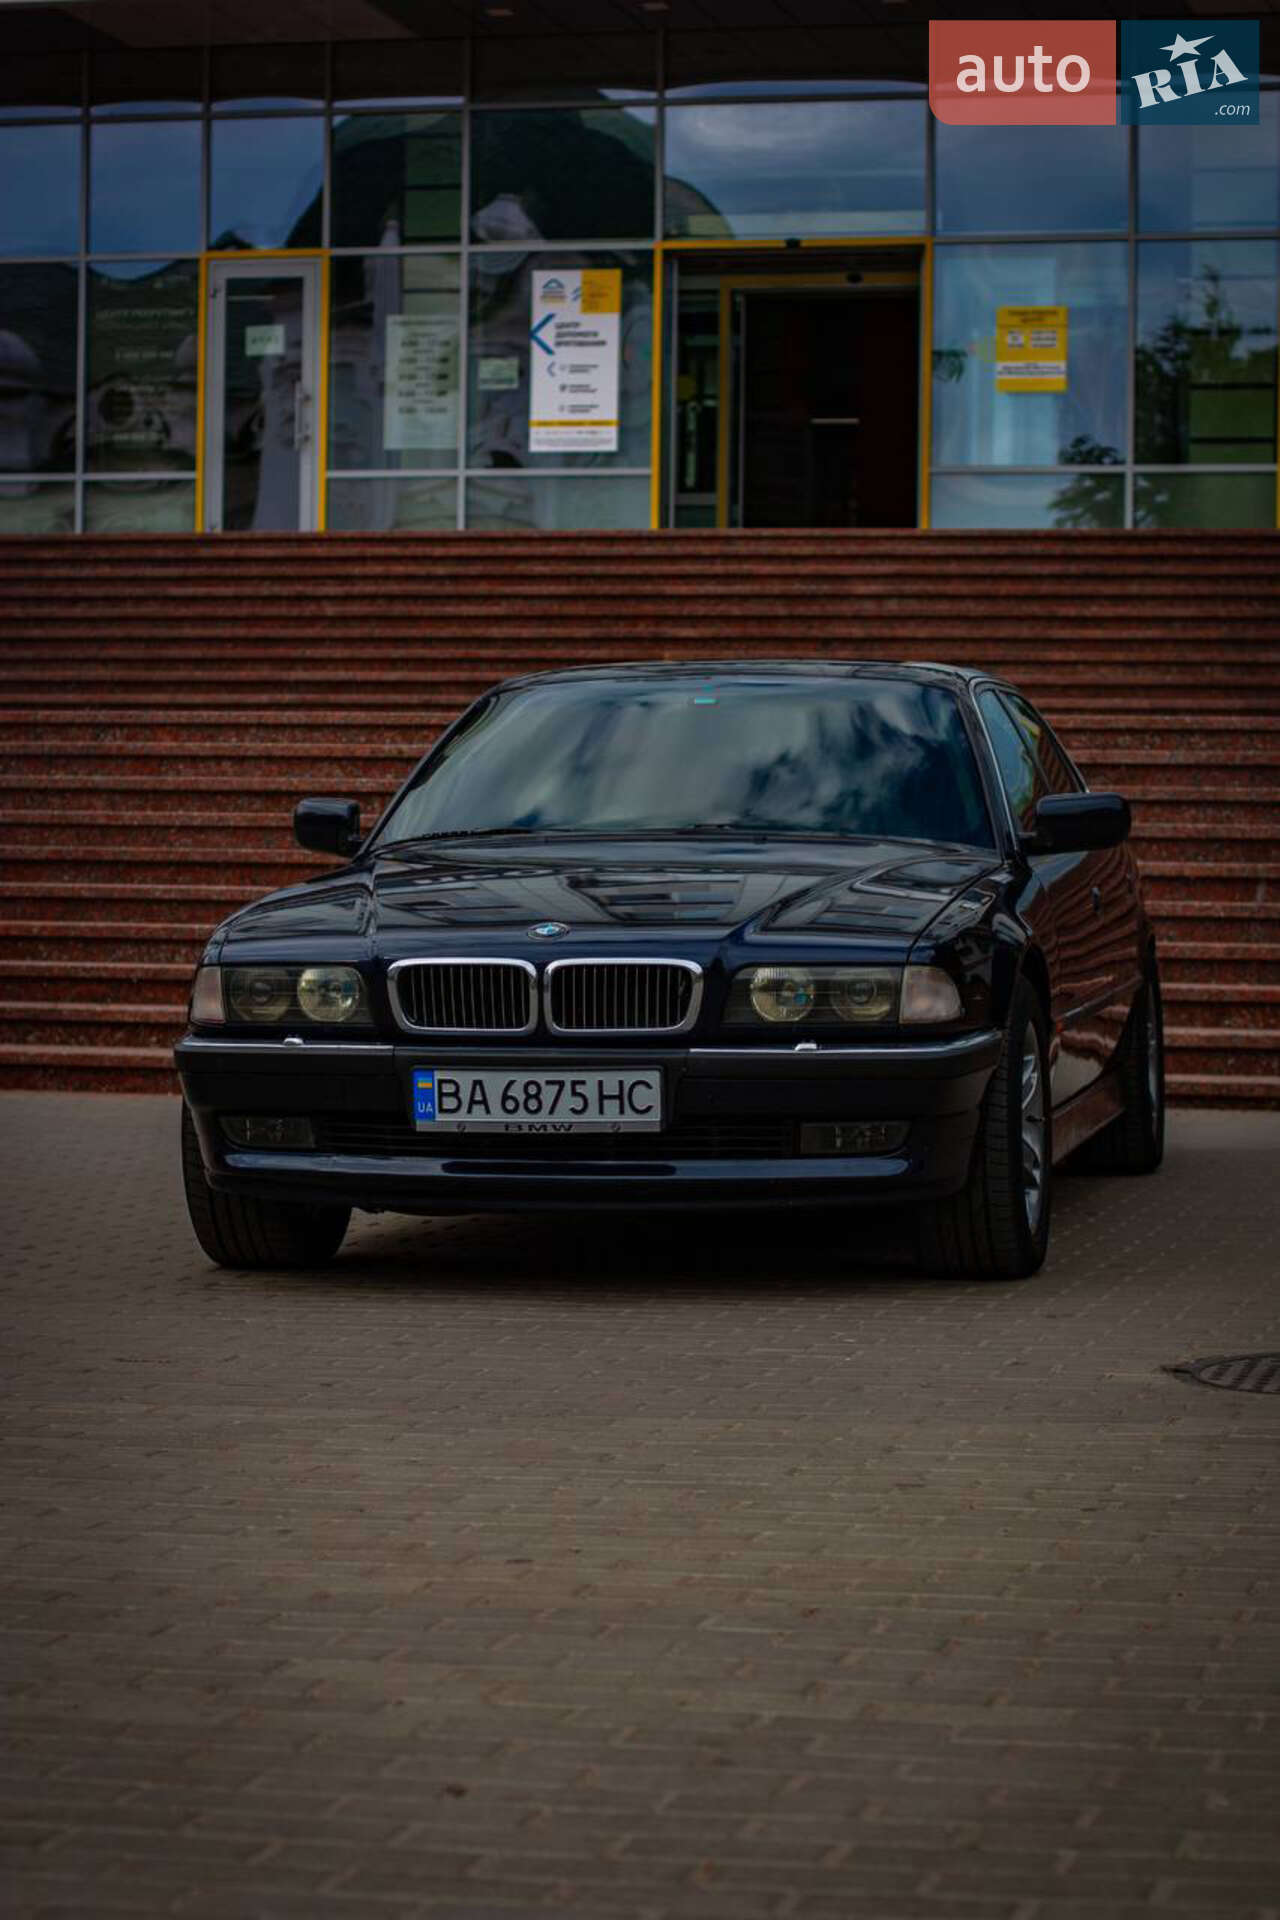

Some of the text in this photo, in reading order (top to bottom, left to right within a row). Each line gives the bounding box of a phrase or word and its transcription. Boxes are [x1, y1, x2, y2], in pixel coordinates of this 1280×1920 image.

[417, 1101, 433, 1113] UA
[437, 1078, 654, 1115] BA 6875 HC
